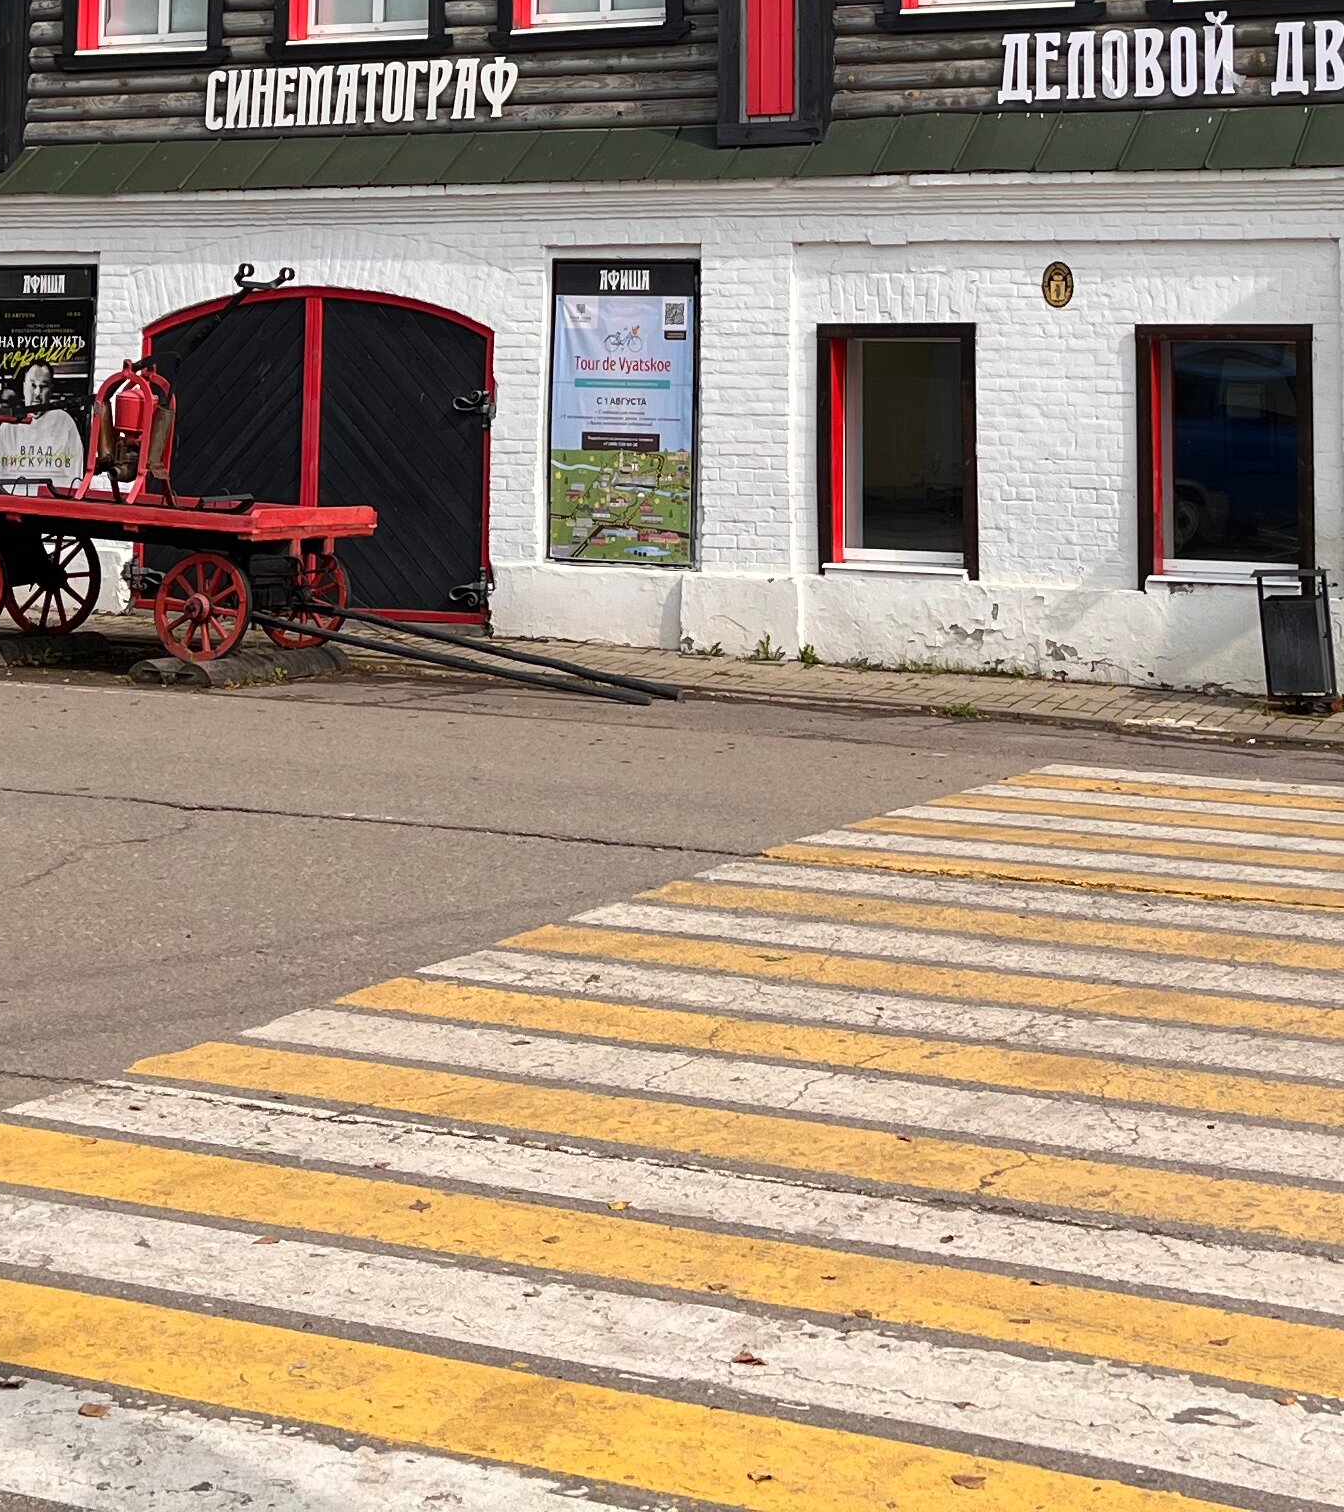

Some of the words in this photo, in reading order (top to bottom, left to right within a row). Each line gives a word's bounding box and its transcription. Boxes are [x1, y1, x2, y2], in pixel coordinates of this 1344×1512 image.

[997, 11, 1237, 105] ДЕЛОВОЙ
[205, 55, 520, 131] СИНЕМАТОГРАФ
[22, 274, 66, 294] АФИША
[599, 269, 650, 291] АФИША
[17, 335, 49, 349] РУСИ
[51, 335, 86, 349] ЖИТЬ
[0, 342, 81, 380] хорошо
[574, 355, 600, 371] Tour
[602, 355, 616, 371] de
[619, 356, 671, 375] Vyatskoe
[596, 396, 603, 405] С
[610, 396, 647, 406] АВГУСТА
[20, 446, 53, 457] ВЛАД
[1, 456, 71, 468] ПИСКУНОВ
